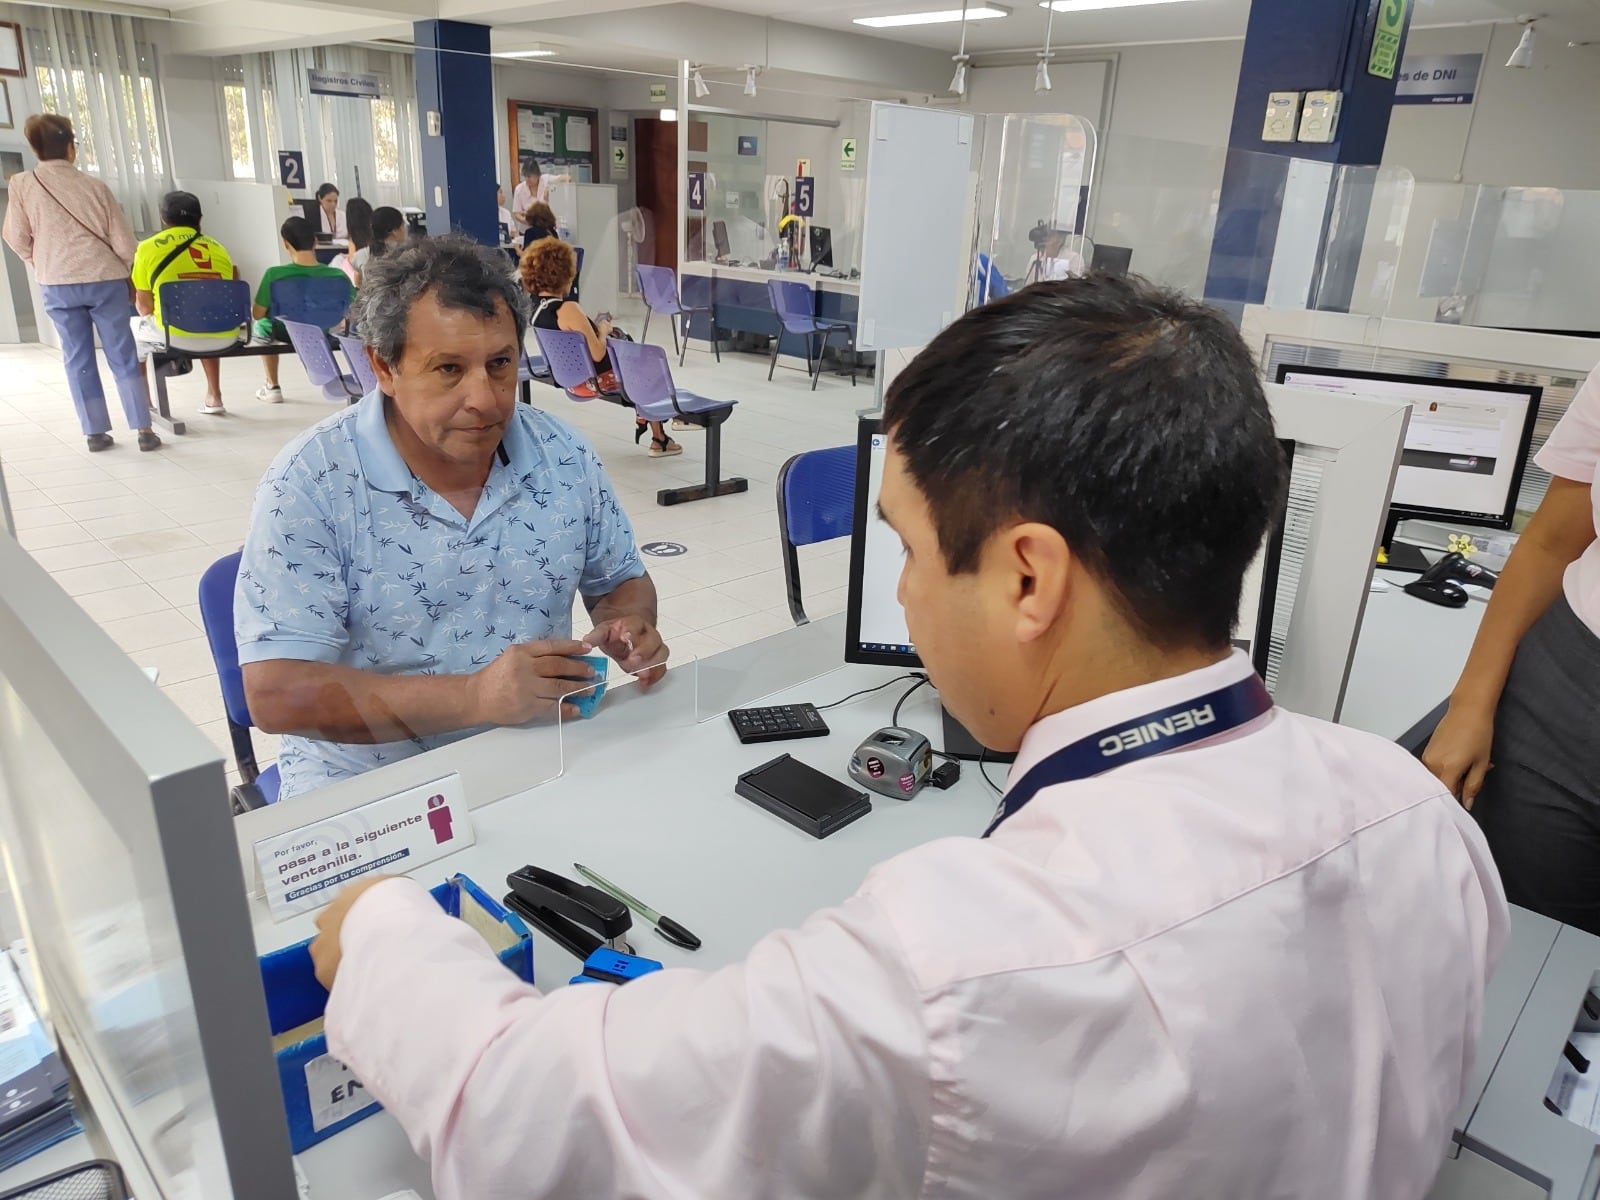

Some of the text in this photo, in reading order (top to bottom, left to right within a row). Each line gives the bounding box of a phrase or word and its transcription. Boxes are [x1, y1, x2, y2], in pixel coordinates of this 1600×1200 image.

[311, 74, 375, 87] Registros Civiles
[1413, 70, 1429, 81] de
[1432, 69, 1457, 80] DNI
[285, 158, 300, 184] 2
[692, 180, 702, 205] 4
[799, 185, 810, 212] 5
[1099, 704, 1216, 757] RENIEC
[274, 849, 290, 858] Por
[278, 815, 423, 875] pasa a la siguiente
[281, 852, 362, 886] ventanilla.
[288, 882, 323, 899] Gracias
[323, 876, 339, 889] por
[340, 871, 350, 881] tu
